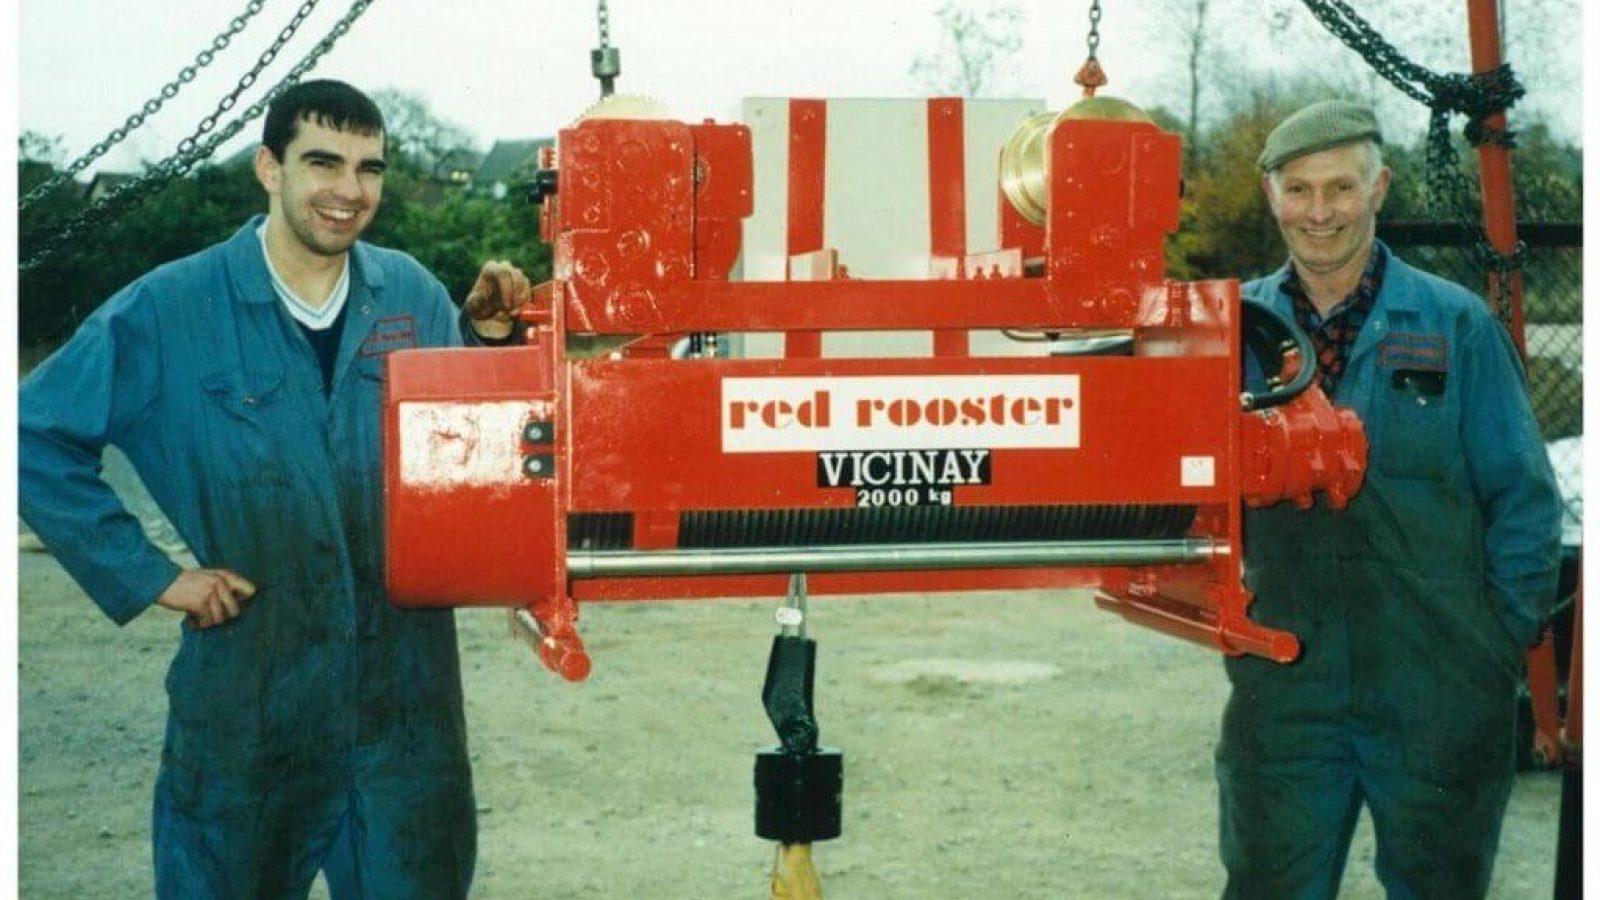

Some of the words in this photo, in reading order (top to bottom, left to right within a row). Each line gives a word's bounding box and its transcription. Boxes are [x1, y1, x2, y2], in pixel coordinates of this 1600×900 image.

[729, 390, 831, 429] red
[856, 392, 1075, 428] rooster
[819, 449, 990, 487] VICINAY
[857, 488, 919, 507] 2000
[928, 487, 952, 506] kg
